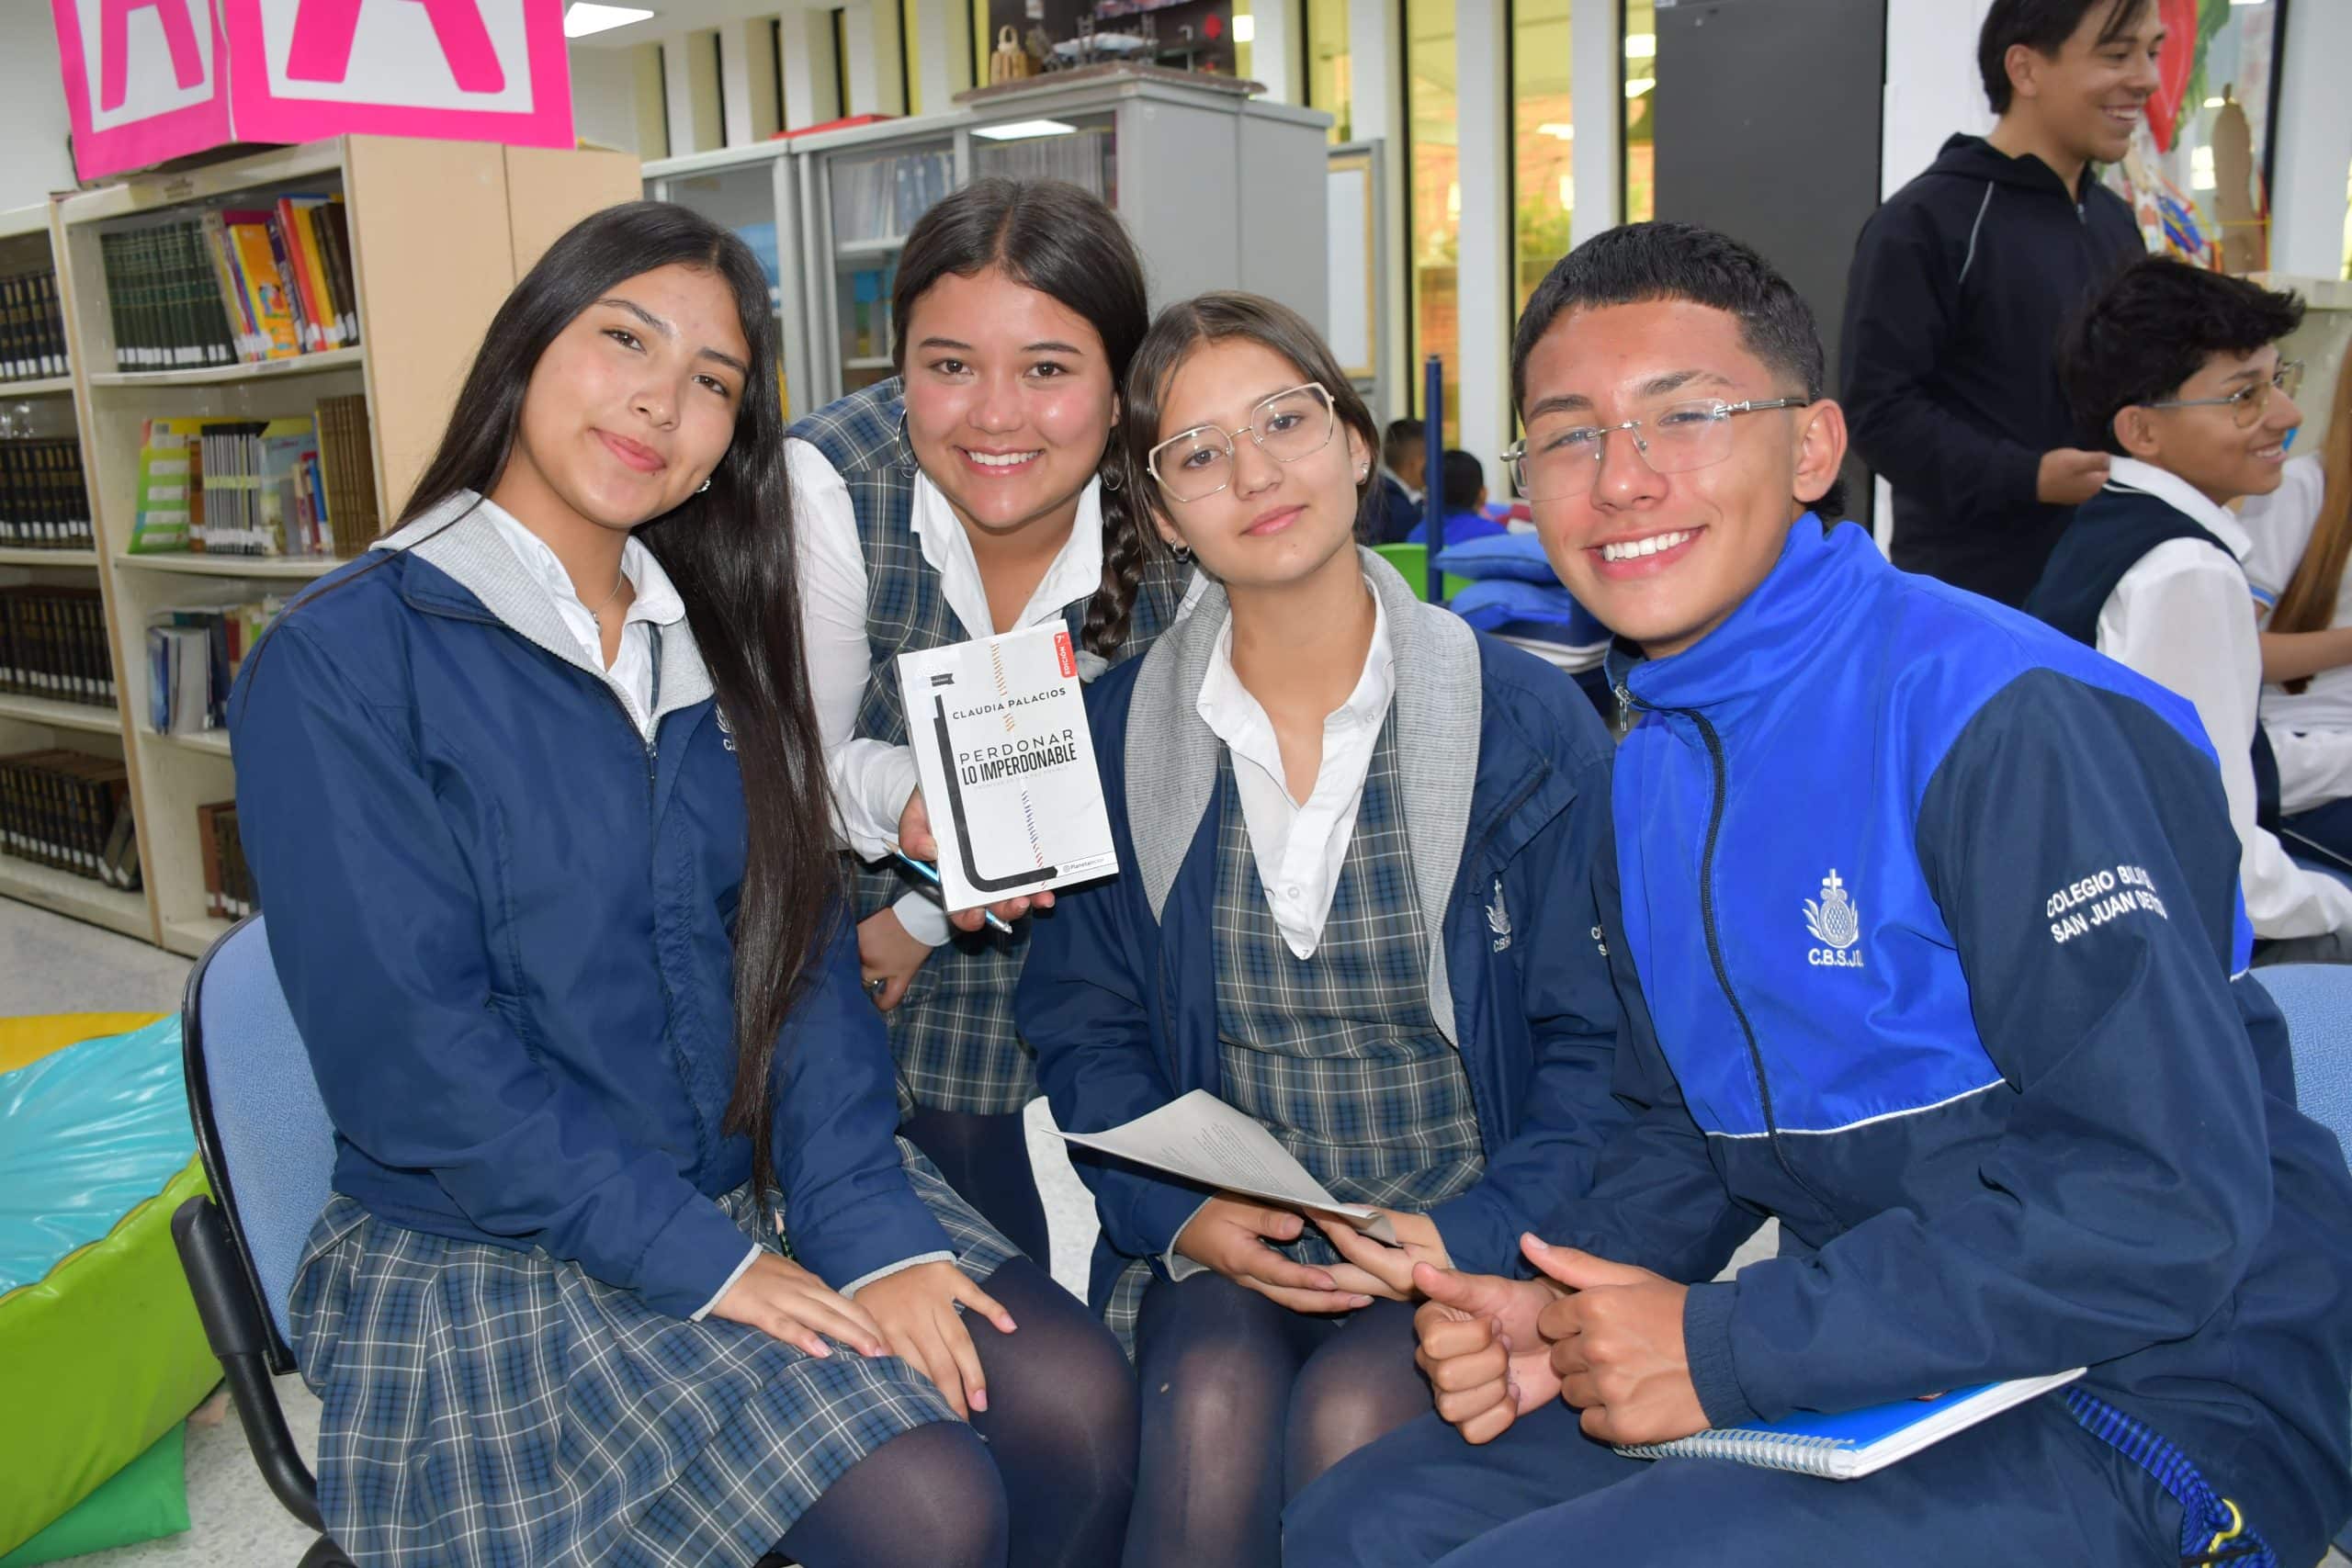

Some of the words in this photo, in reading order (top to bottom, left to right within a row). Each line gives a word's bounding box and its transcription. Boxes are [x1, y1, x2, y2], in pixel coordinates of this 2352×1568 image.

[953, 704, 1004, 719] CLAUDIA
[1008, 688, 1066, 707] PALACIOS
[959, 729, 1073, 764] PERDONAR
[961, 765, 978, 785] LO
[979, 742, 1077, 782] IMPERDONABLE
[2046, 870, 2115, 918] COLEGIO
[2051, 912, 2089, 943] SAN
[2089, 890, 2138, 926] JUAN
